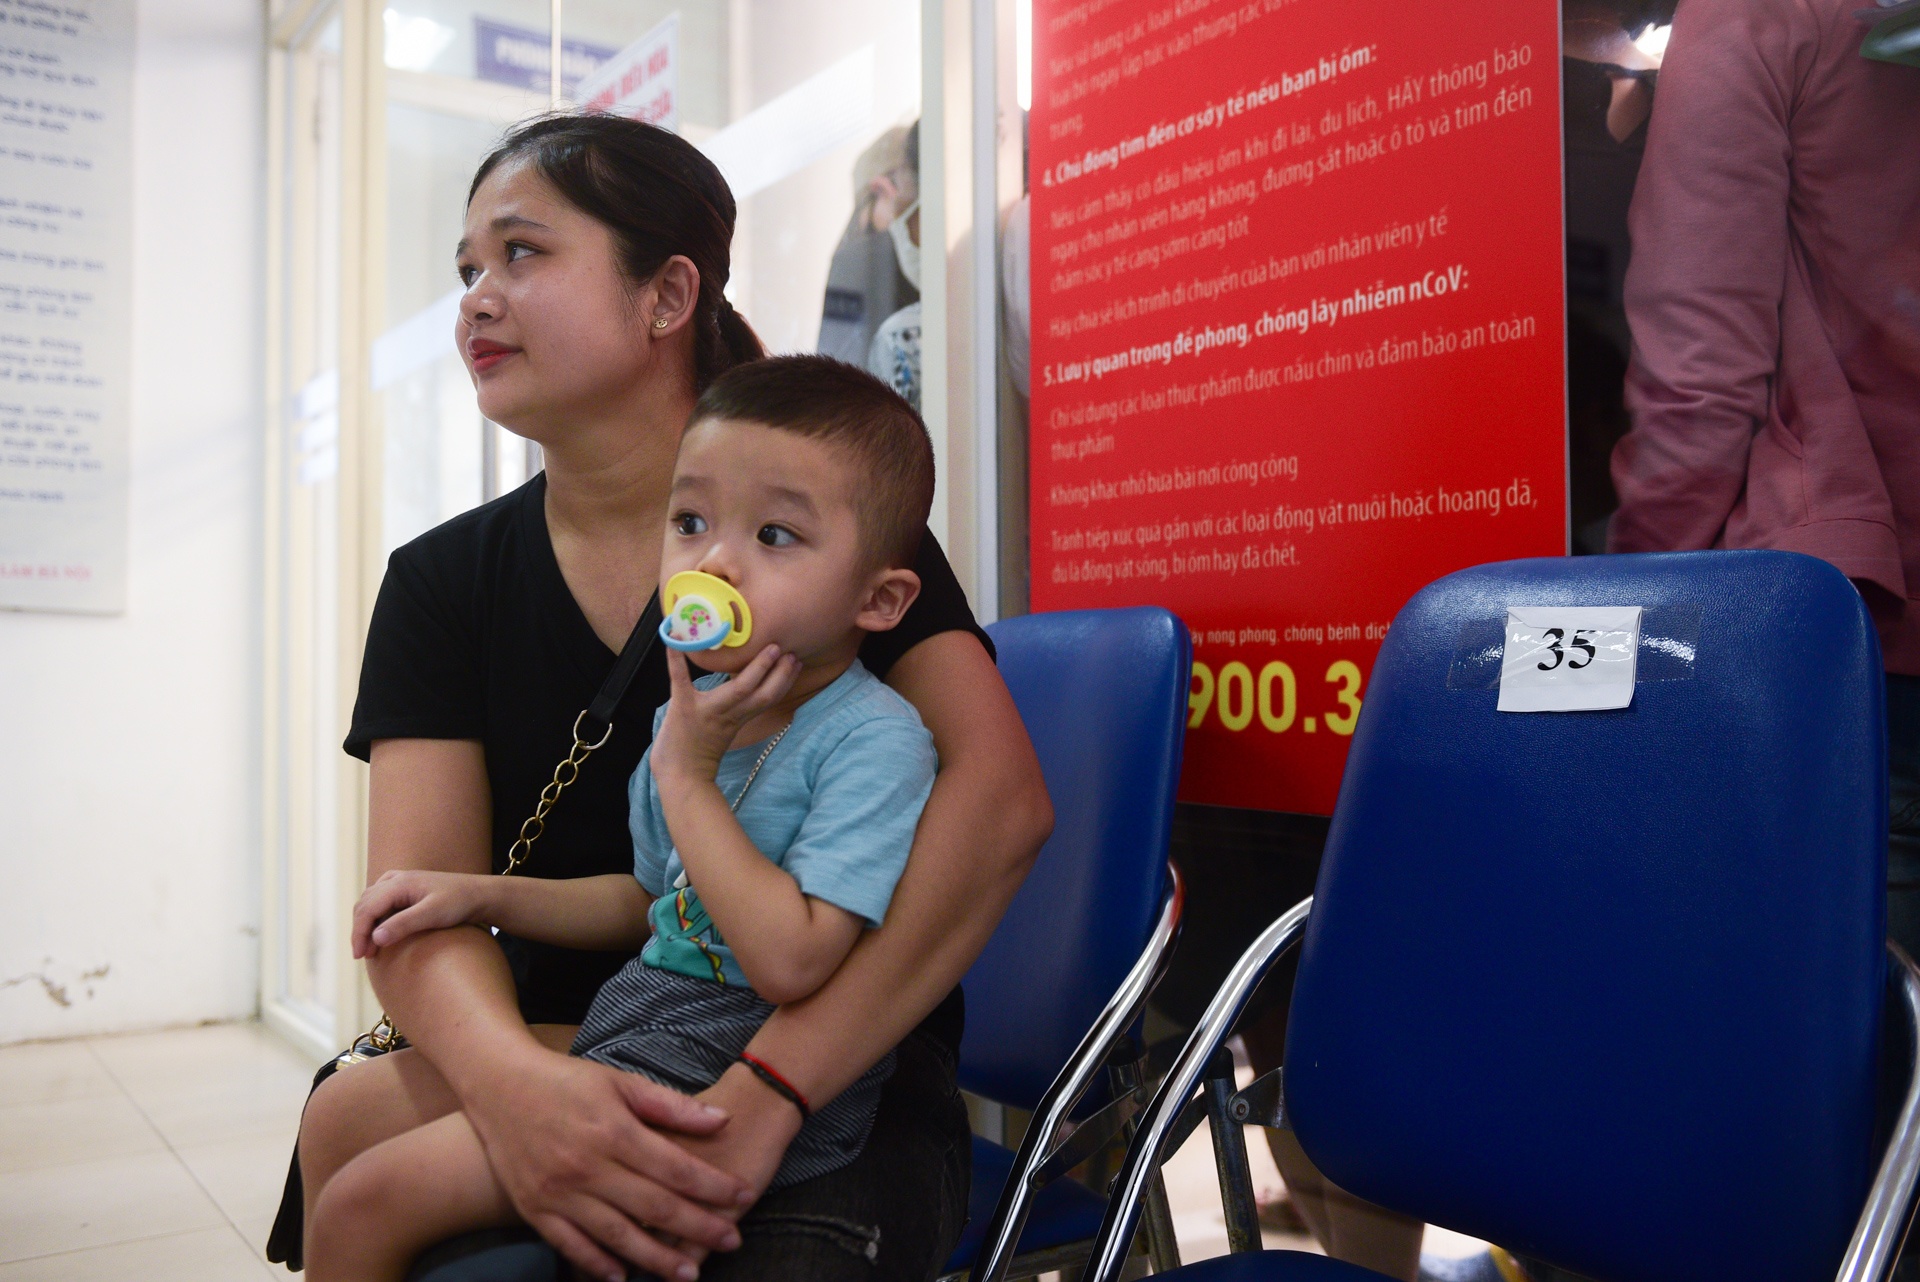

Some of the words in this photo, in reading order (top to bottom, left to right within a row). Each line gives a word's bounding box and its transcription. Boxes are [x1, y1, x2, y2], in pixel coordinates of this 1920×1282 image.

[1043, 168, 1056, 187] 4.
[1082, 143, 1119, 174] động
[1147, 117, 1177, 150] đến
[1215, 103, 1226, 129] y
[1227, 86, 1246, 118] tế
[1246, 76, 1281, 111] nếu
[1281, 70, 1317, 98] bạn
[1318, 52, 1338, 86] bị
[1339, 43, 1378, 74] ốm:
[1245, 136, 1269, 162] khi
[1271, 126, 1287, 153] đi
[1320, 109, 1342, 136] du
[1347, 94, 1382, 129] lịch,
[1387, 74, 1423, 112] HÃY
[1430, 60, 1487, 98] thông
[1494, 41, 1532, 75] báo
[1317, 148, 1341, 175] sắt
[1345, 134, 1386, 166] hoặc
[1390, 124, 1401, 150] ô
[1406, 116, 1425, 145] tô
[1429, 107, 1449, 137] và
[1456, 99, 1488, 130] tìm
[1494, 79, 1532, 117] đến
[1269, 251, 1300, 283] bạn
[1302, 240, 1325, 271] với
[1329, 230, 1371, 262] nhân
[1375, 220, 1412, 251] viên
[1415, 220, 1427, 249] y
[1430, 203, 1449, 237] tế
[1043, 364, 1057, 387] 5.
[1093, 350, 1128, 379] quan
[1130, 340, 1171, 370] trọng
[1195, 321, 1252, 358] phòng,
[1255, 303, 1309, 337] chống
[1312, 296, 1339, 327] lây
[1342, 279, 1405, 317] nhiễm
[1409, 263, 1469, 303] nCoV:
[1200, 369, 1242, 406] phẩm
[1244, 362, 1281, 395] được
[1284, 353, 1314, 384] nấu
[1317, 347, 1351, 378] chín
[1355, 340, 1374, 369] và
[1378, 333, 1418, 366] đảm
[1422, 325, 1457, 357] bảo
[1461, 325, 1485, 350] an
[1489, 311, 1536, 344] toàn
[1193, 511, 1213, 538] với
[1216, 509, 1239, 535] các
[1242, 506, 1270, 537] loại
[1273, 502, 1314, 534] động
[1318, 498, 1343, 530] vật
[1348, 493, 1386, 522] nuôi
[1391, 490, 1433, 522] hoặc
[1438, 486, 1500, 517] hoang
[1506, 477, 1538, 510] dã,
[1223, 458, 1258, 487] công
[1260, 452, 1298, 483] cộng
[1188, 548, 1211, 573] ốm
[1213, 547, 1240, 577] hay
[1241, 543, 1260, 569] đã
[1262, 538, 1300, 568] chết.
[1190, 627, 1203, 647] ây
[1284, 620, 1323, 646] chống
[1328, 621, 1360, 645] bệnh
[1537, 627, 1596, 671] 35
